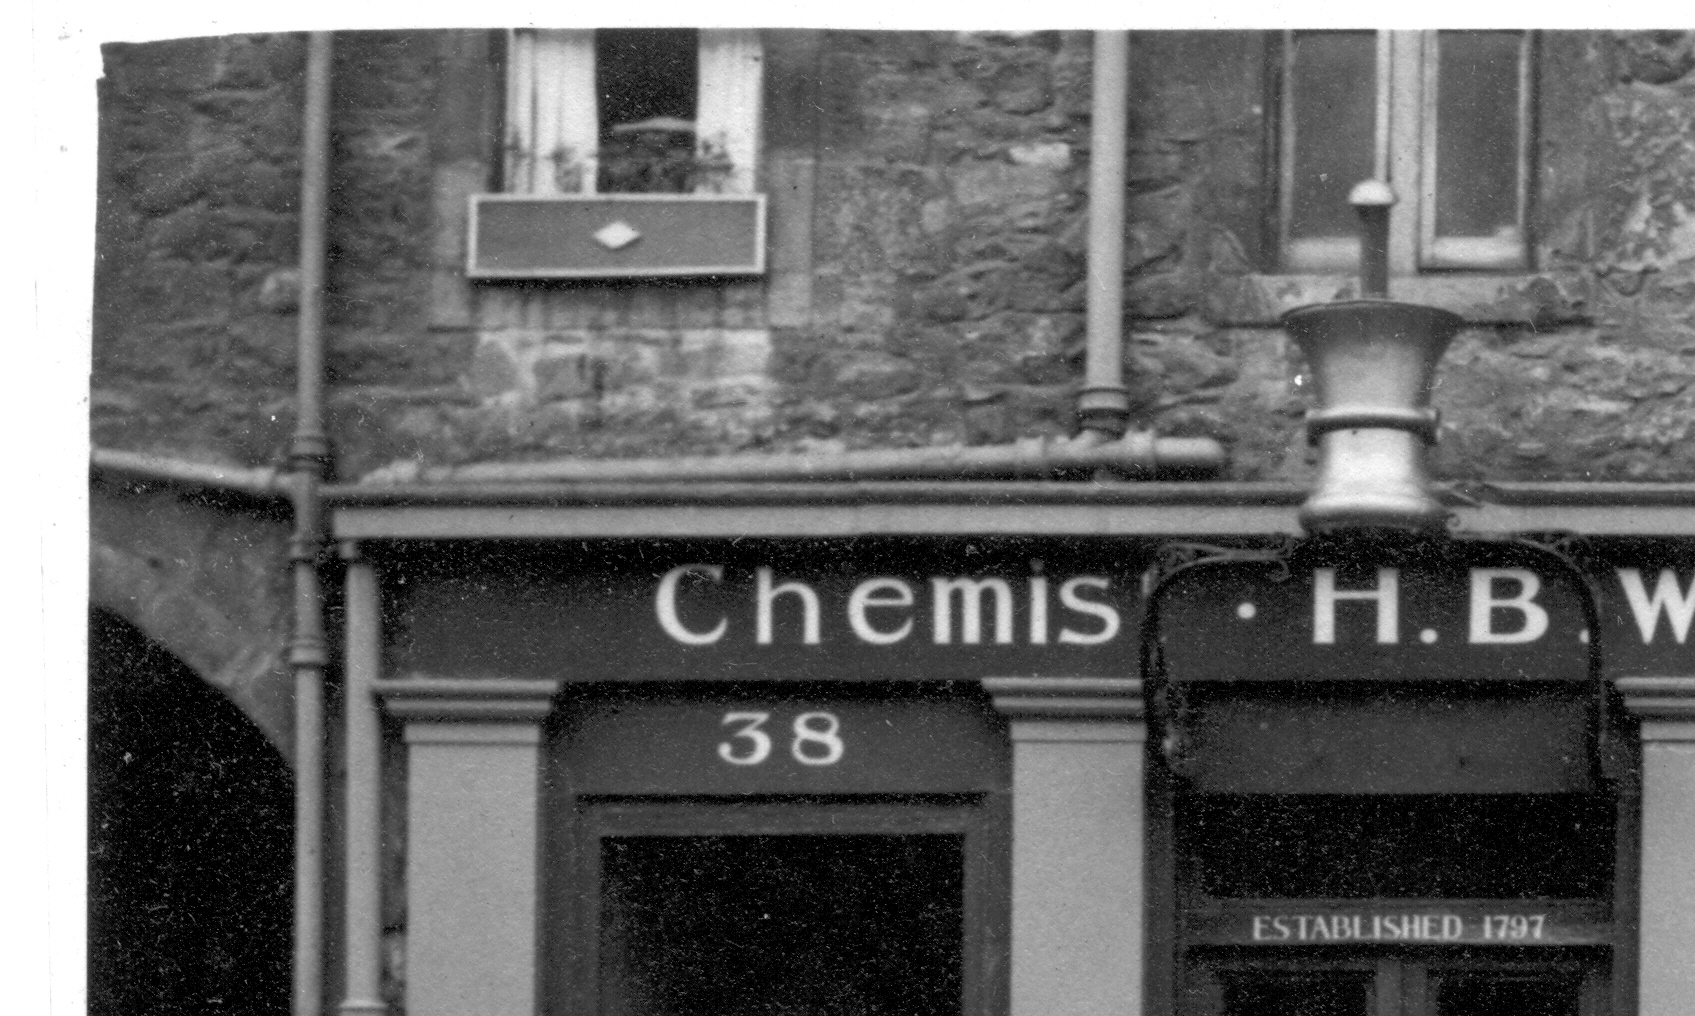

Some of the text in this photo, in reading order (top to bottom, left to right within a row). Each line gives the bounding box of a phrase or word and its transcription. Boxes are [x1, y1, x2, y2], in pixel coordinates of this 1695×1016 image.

[655, 561, 1152, 645] Chemis
[717, 711, 845, 766] 38
[1252, 914, 1547, 941] ESTABLISHED 1797
